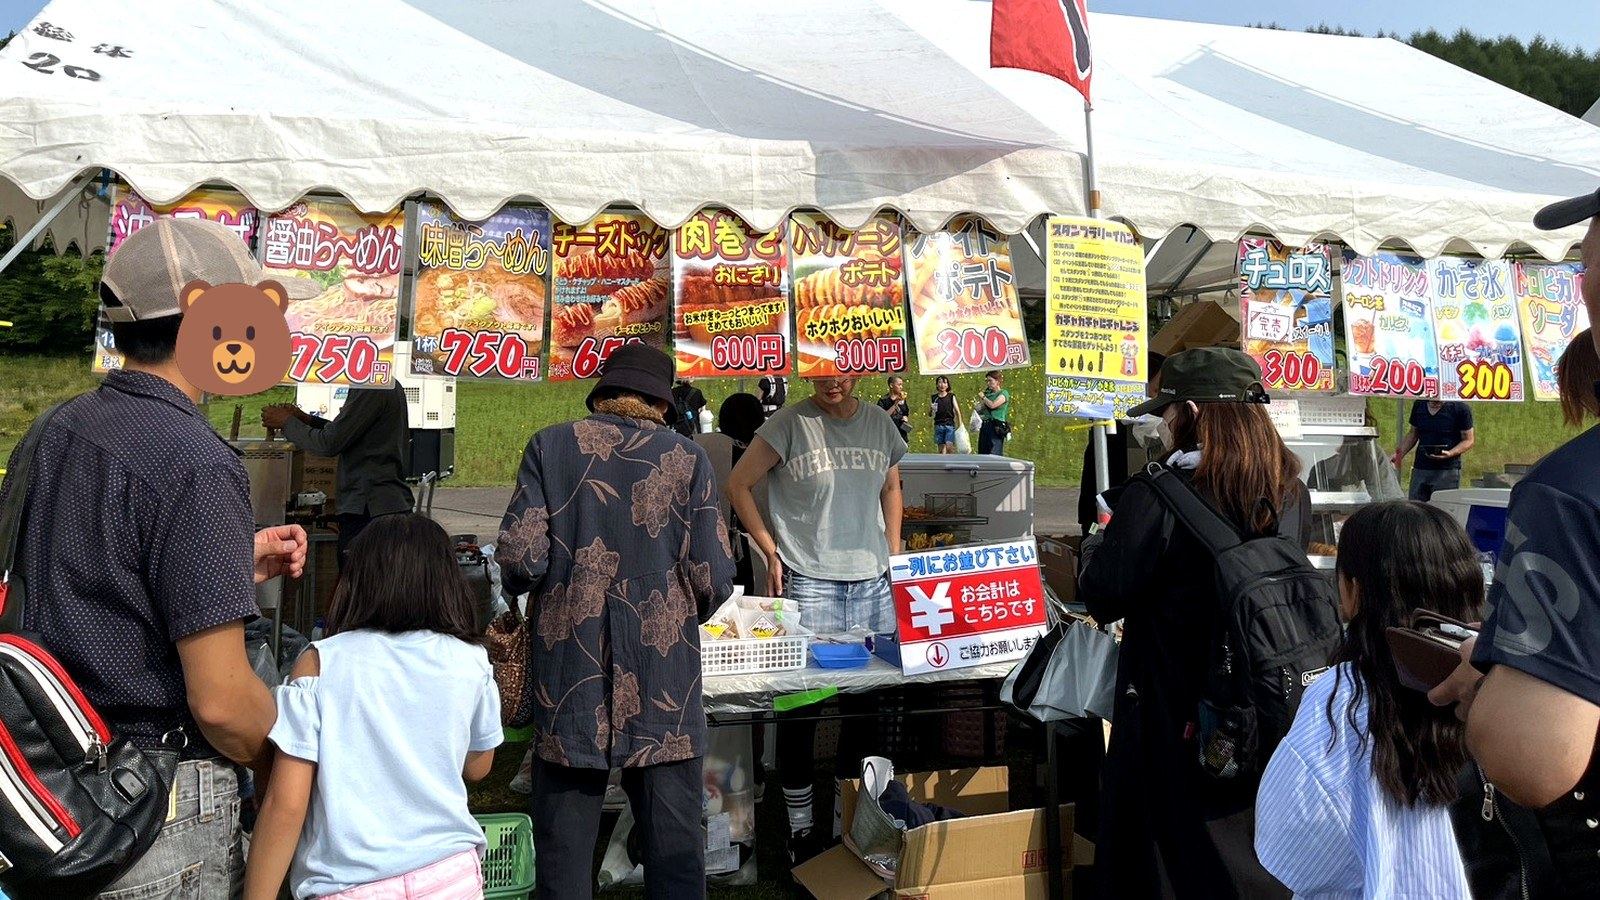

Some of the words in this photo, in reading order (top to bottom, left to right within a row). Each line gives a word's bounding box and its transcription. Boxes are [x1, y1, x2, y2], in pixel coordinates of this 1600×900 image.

[21, 52, 102, 82] 20
[714, 264, 782, 286] おにぎり
[842, 261, 900, 286] ポテト
[935, 258, 1013, 301] ポテト
[1242, 248, 1331, 293] チュロス
[1435, 260, 1504, 301] かき氷
[1346, 292, 1385, 311] ウーロン茶
[1434, 304, 1459, 320] レモン
[1492, 304, 1512, 319] メロン
[706, 314, 769, 333] さめてもおいしい！
[806, 308, 902, 338] ホクホクおいしい！
[1258, 316, 1281, 333] 完売
[1528, 300, 1577, 338] ソーダ
[415, 337, 438, 353] 1杯
[440, 329, 540, 379] 750円
[711, 334, 785, 370] 600円
[834, 337, 905, 371] 300円
[937, 326, 1025, 370] 300円
[1440, 344, 1467, 362] イチゴ
[1369, 355, 1438, 397] 200円
[1057, 404, 1079, 415] メロン
[892, 544, 1036, 577] 一列にお並び下さい
[960, 578, 1021, 604] お会計は
[963, 597, 1037, 624] こちらです
